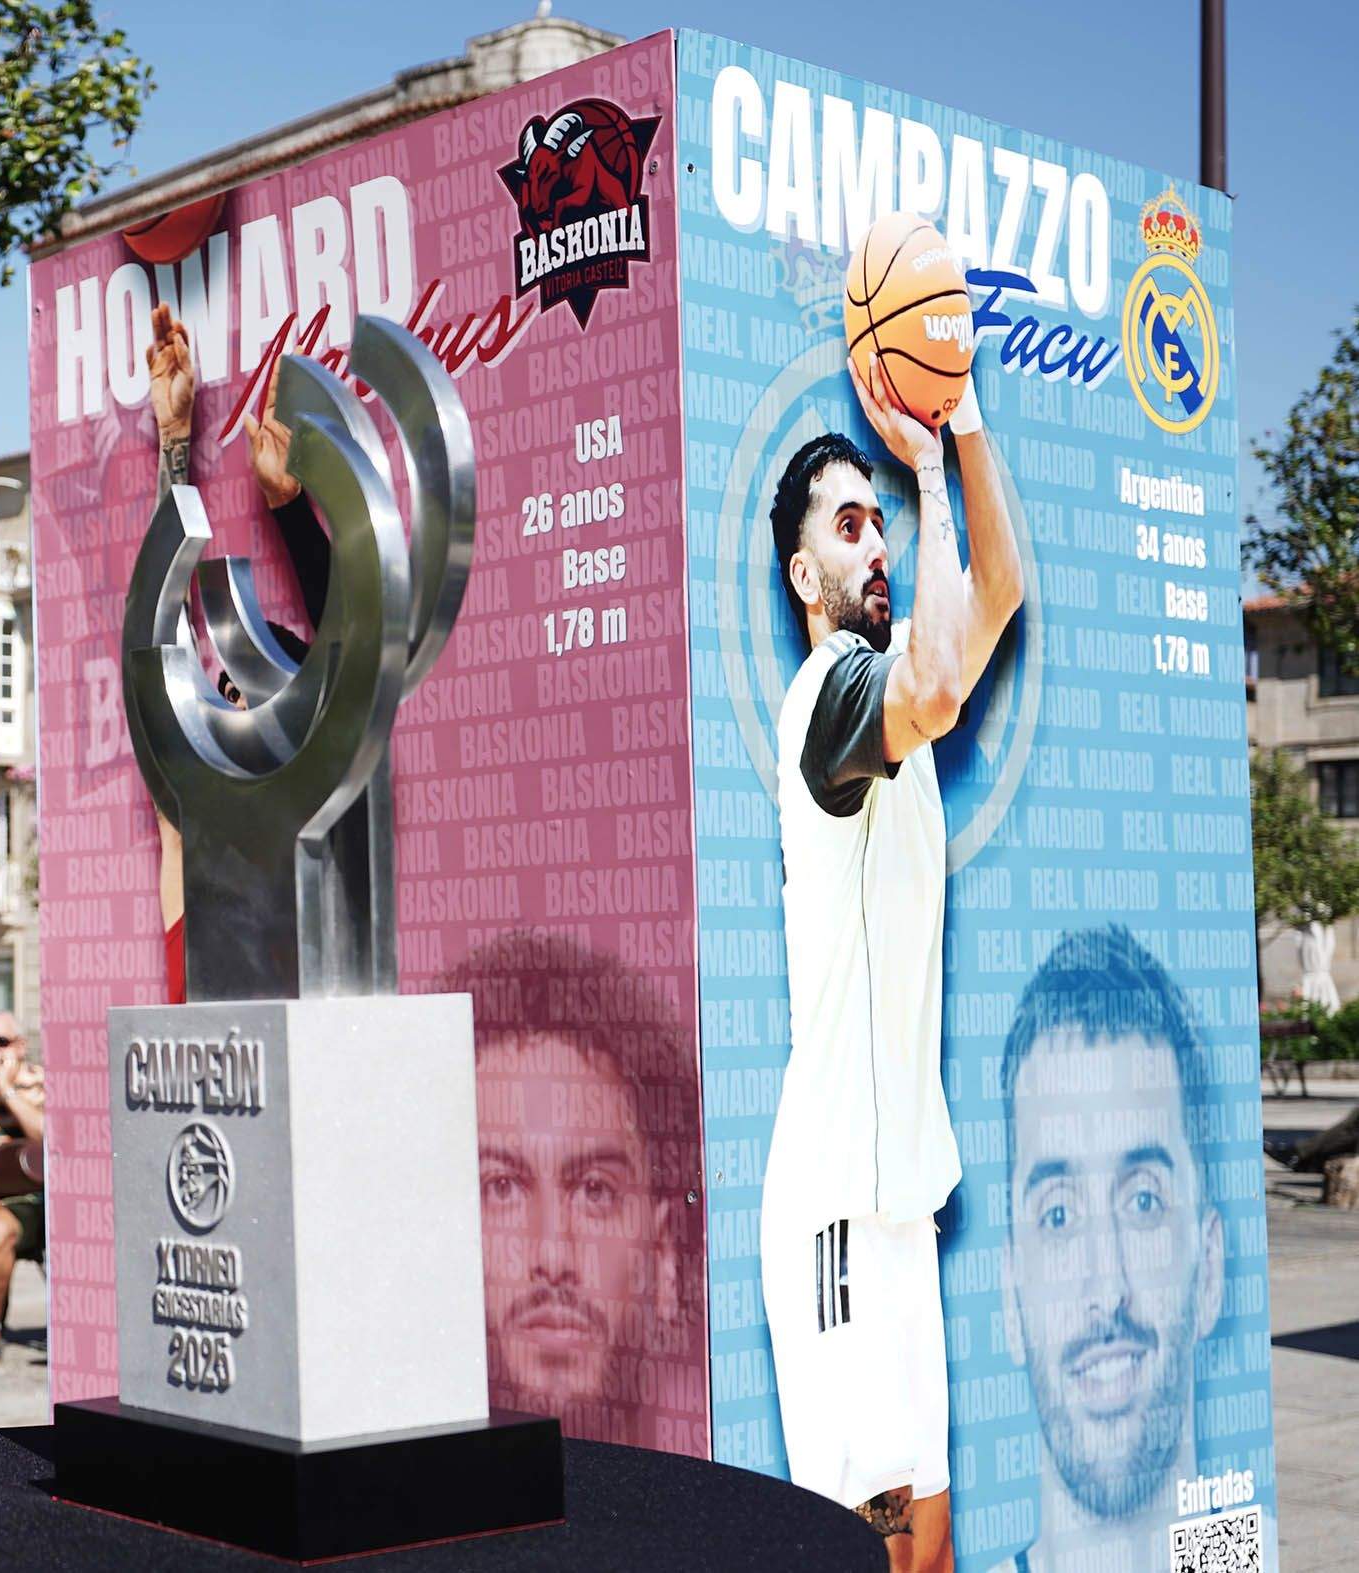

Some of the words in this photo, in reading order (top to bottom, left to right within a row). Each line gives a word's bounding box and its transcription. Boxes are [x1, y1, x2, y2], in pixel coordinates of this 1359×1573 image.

[711, 65, 1112, 316] CAMPAZZO
[519, 204, 646, 287] BASKONIA
[56, 176, 414, 422] HOWARD
[544, 271, 582, 298] VITORIA
[584, 257, 626, 287] GASTEIZ
[964, 267, 1121, 384] Facu
[526, 315, 666, 400] BASKONIA
[688, 301, 745, 362] REAL
[1018, 375, 1067, 427] REAL
[1070, 386, 1146, 444] MADRID
[473, 392, 578, 465] SKONIA
[574, 415, 623, 464] USA
[1018, 435, 1097, 491] MADRID
[521, 492, 554, 537] 26
[559, 483, 625, 530] anos
[1120, 467, 1204, 517] Argentina
[562, 547, 626, 591] Base
[1136, 524, 1160, 559] 34
[1162, 531, 1206, 569] anos
[1114, 571, 1161, 619] REAL
[1165, 580, 1208, 622] Base
[543, 609, 592, 656] 1,78
[596, 605, 627, 643] m
[1074, 626, 1151, 676] MADRID
[1153, 634, 1188, 674] 1,78
[1190, 646, 1210, 675] m
[535, 640, 674, 711] BASKONIA
[458, 706, 586, 772] BASKONIA
[1117, 690, 1165, 735] REAL
[1168, 694, 1243, 742] MADRID
[396, 767, 519, 829] BASKONIA
[539, 748, 677, 817] BASKONIA
[1024, 743, 1074, 790] REAL
[1077, 745, 1154, 794] MADRID
[1170, 753, 1217, 797] REAL
[461, 810, 591, 873] BASKONIA
[697, 788, 781, 840] MADRI
[1026, 804, 1106, 852] MADRID
[1121, 808, 1168, 852] REAL
[1172, 810, 1246, 856] MADRID
[65, 845, 157, 899] BASKONI
[398, 869, 522, 929] BASKONIA
[543, 858, 681, 923] BASKONIA
[699, 857, 757, 908] REAL
[953, 864, 1013, 911] ADRID
[1029, 866, 1078, 912] REAL
[1082, 867, 1160, 913] MADRID
[1175, 870, 1221, 913] REAL
[65, 933, 159, 984] BASKONI
[701, 927, 787, 978] MADRI
[976, 928, 1027, 973] REAL
[1177, 928, 1251, 969] MADRID
[703, 998, 761, 1048] REAL
[126, 1027, 265, 1115] CAMPEÓN
[704, 1067, 785, 1119] MADRI
[173, 1243, 241, 1294] TORNEO
[168, 1328, 236, 1393] 2025
[1196, 1388, 1269, 1441] MADRID
[715, 1416, 775, 1475] REAL
[1176, 1468, 1255, 1519] Entradas
